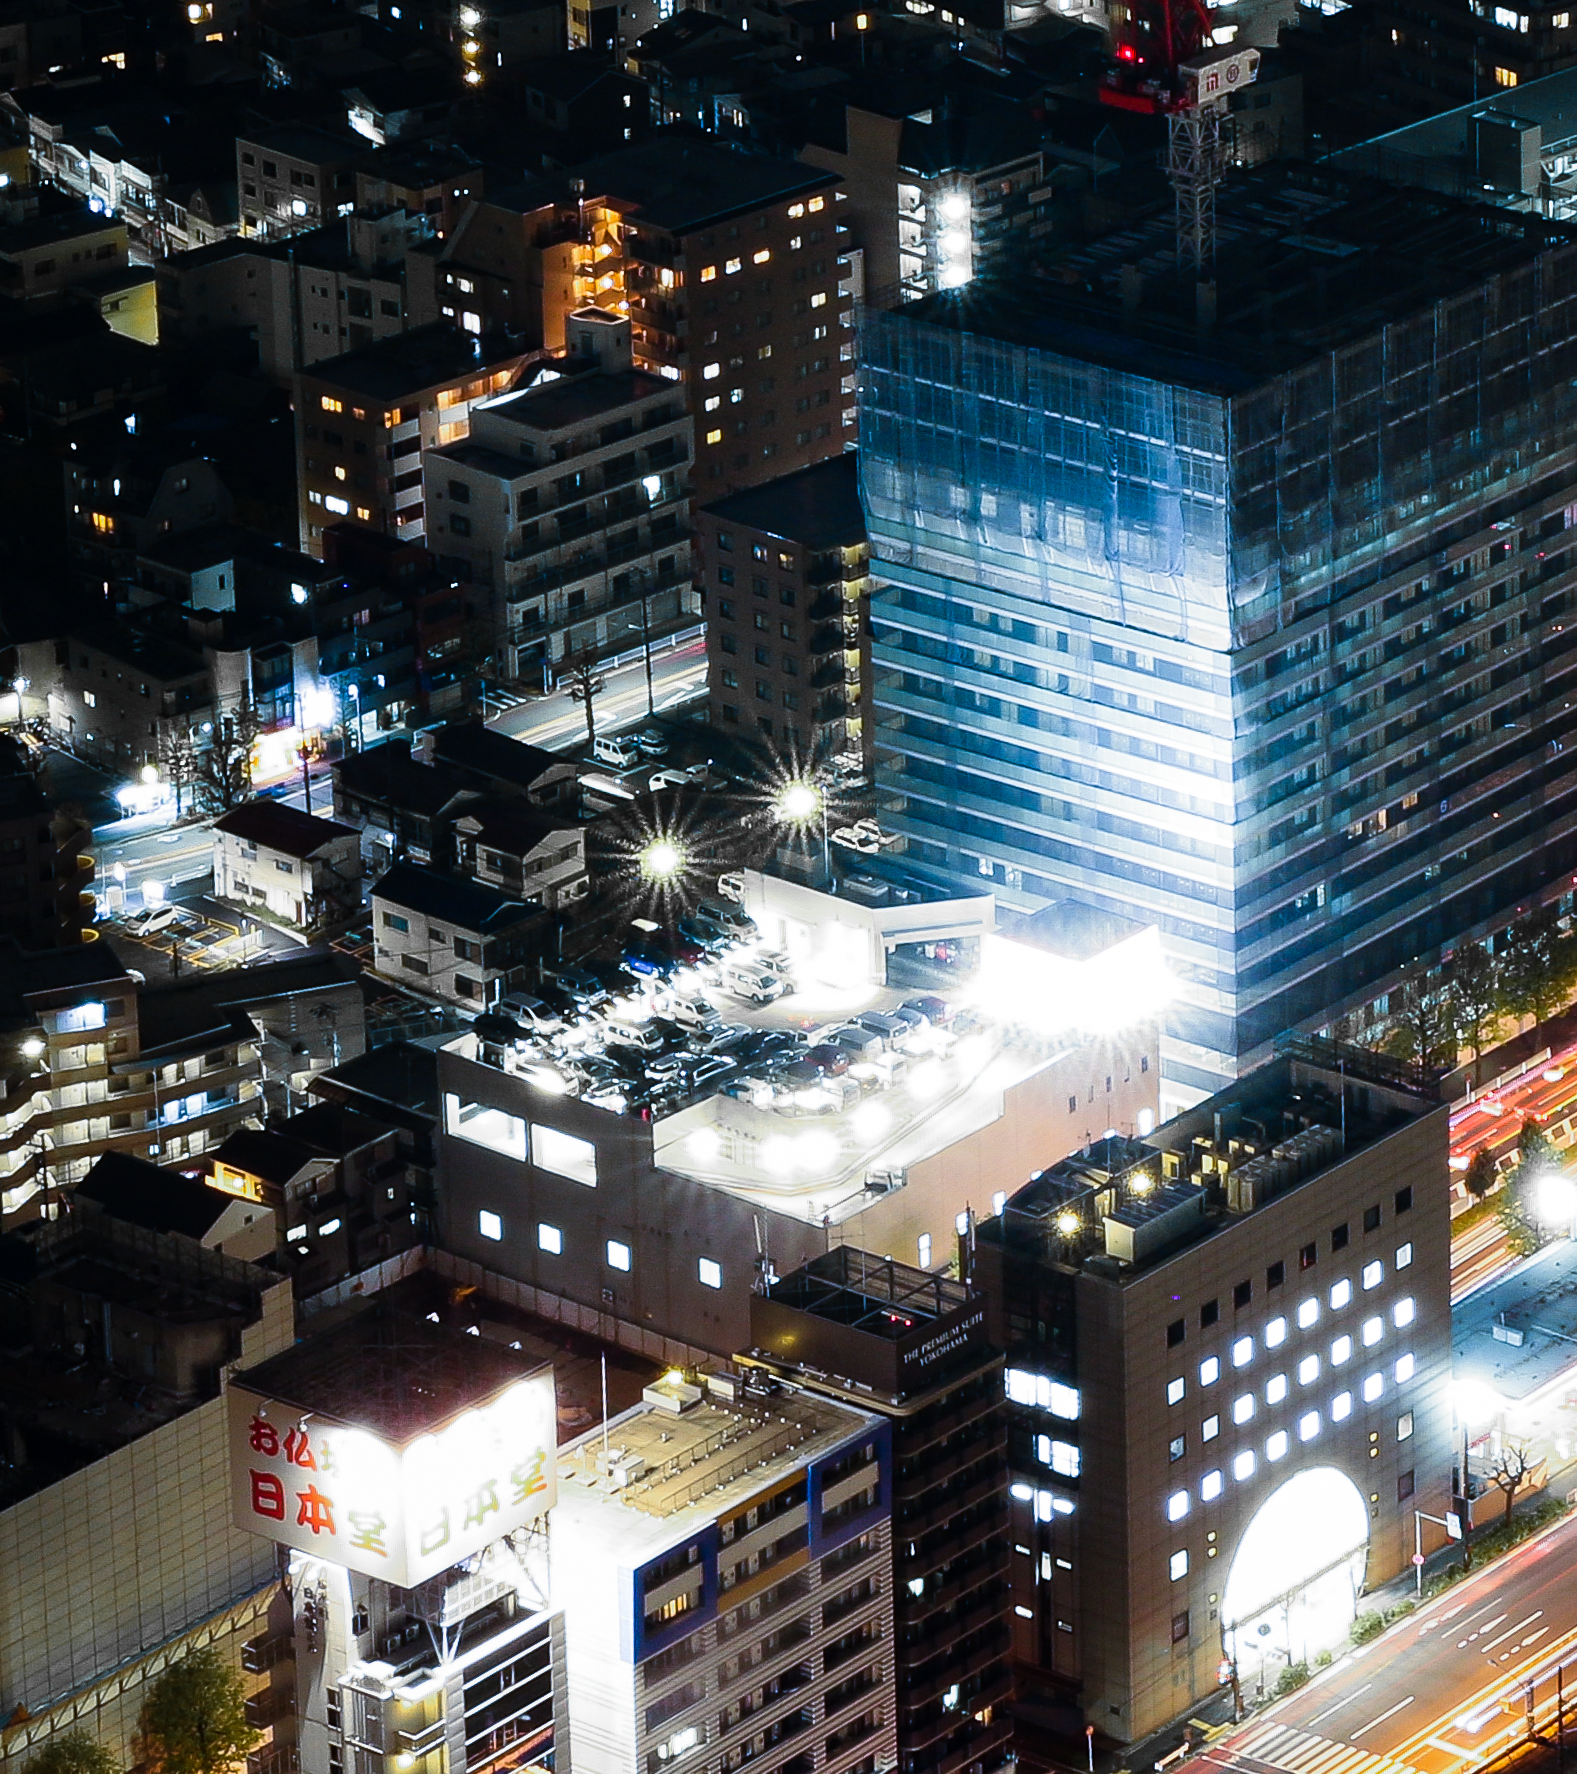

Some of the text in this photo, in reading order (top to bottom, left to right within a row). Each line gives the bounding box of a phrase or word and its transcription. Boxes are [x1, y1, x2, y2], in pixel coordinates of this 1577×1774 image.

[904, 1311, 983, 1364] THE PREMIUM SUITE
[920, 1333, 968, 1367] YOKOHAMA
[249, 1468, 388, 1559] 日本堂
